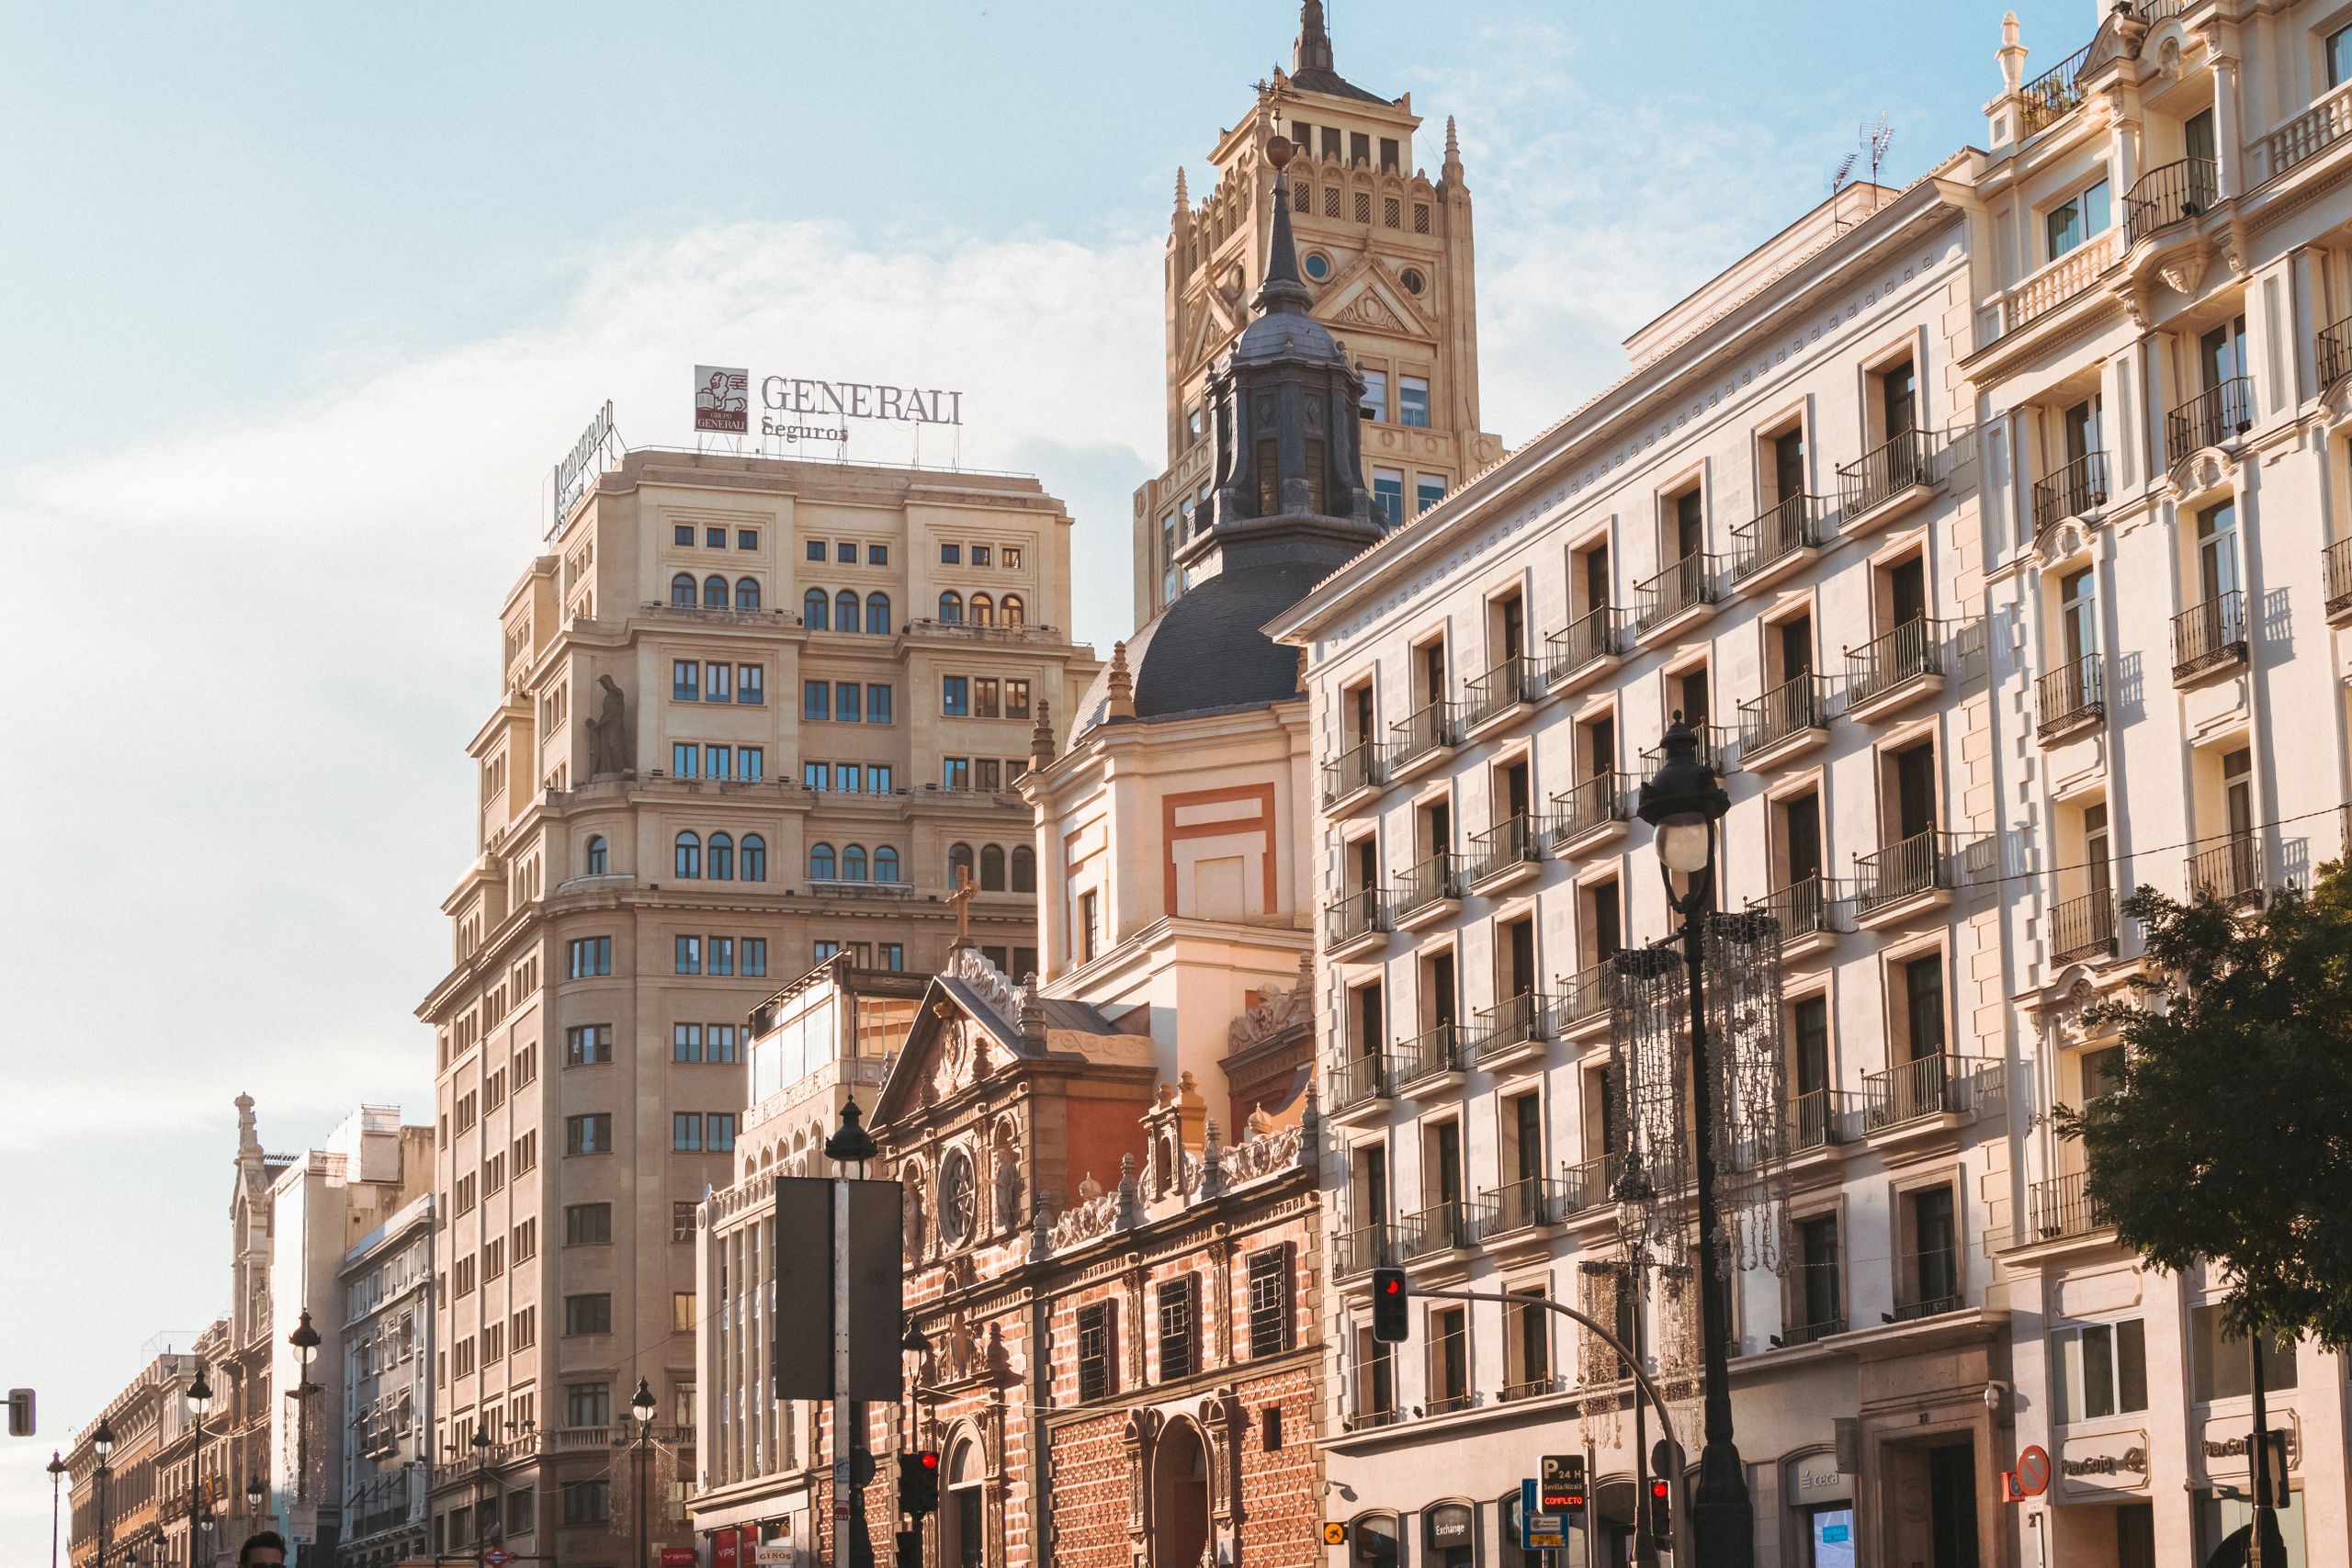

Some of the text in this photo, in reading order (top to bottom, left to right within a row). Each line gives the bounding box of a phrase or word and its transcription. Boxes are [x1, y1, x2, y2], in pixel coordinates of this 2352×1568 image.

[762, 376, 963, 425] GENERALI
[698, 418, 744, 430] GENERALI
[762, 416, 848, 443] Seguros
[1544, 1460, 1558, 1479] P
[1559, 1471, 1581, 1479] 24 H
[1814, 1473, 1838, 1486] ceca
[1544, 1496, 1582, 1505] COMPLETO
[1436, 1524, 1464, 1535] Exchange
[718, 1547, 735, 1557] VIPS
